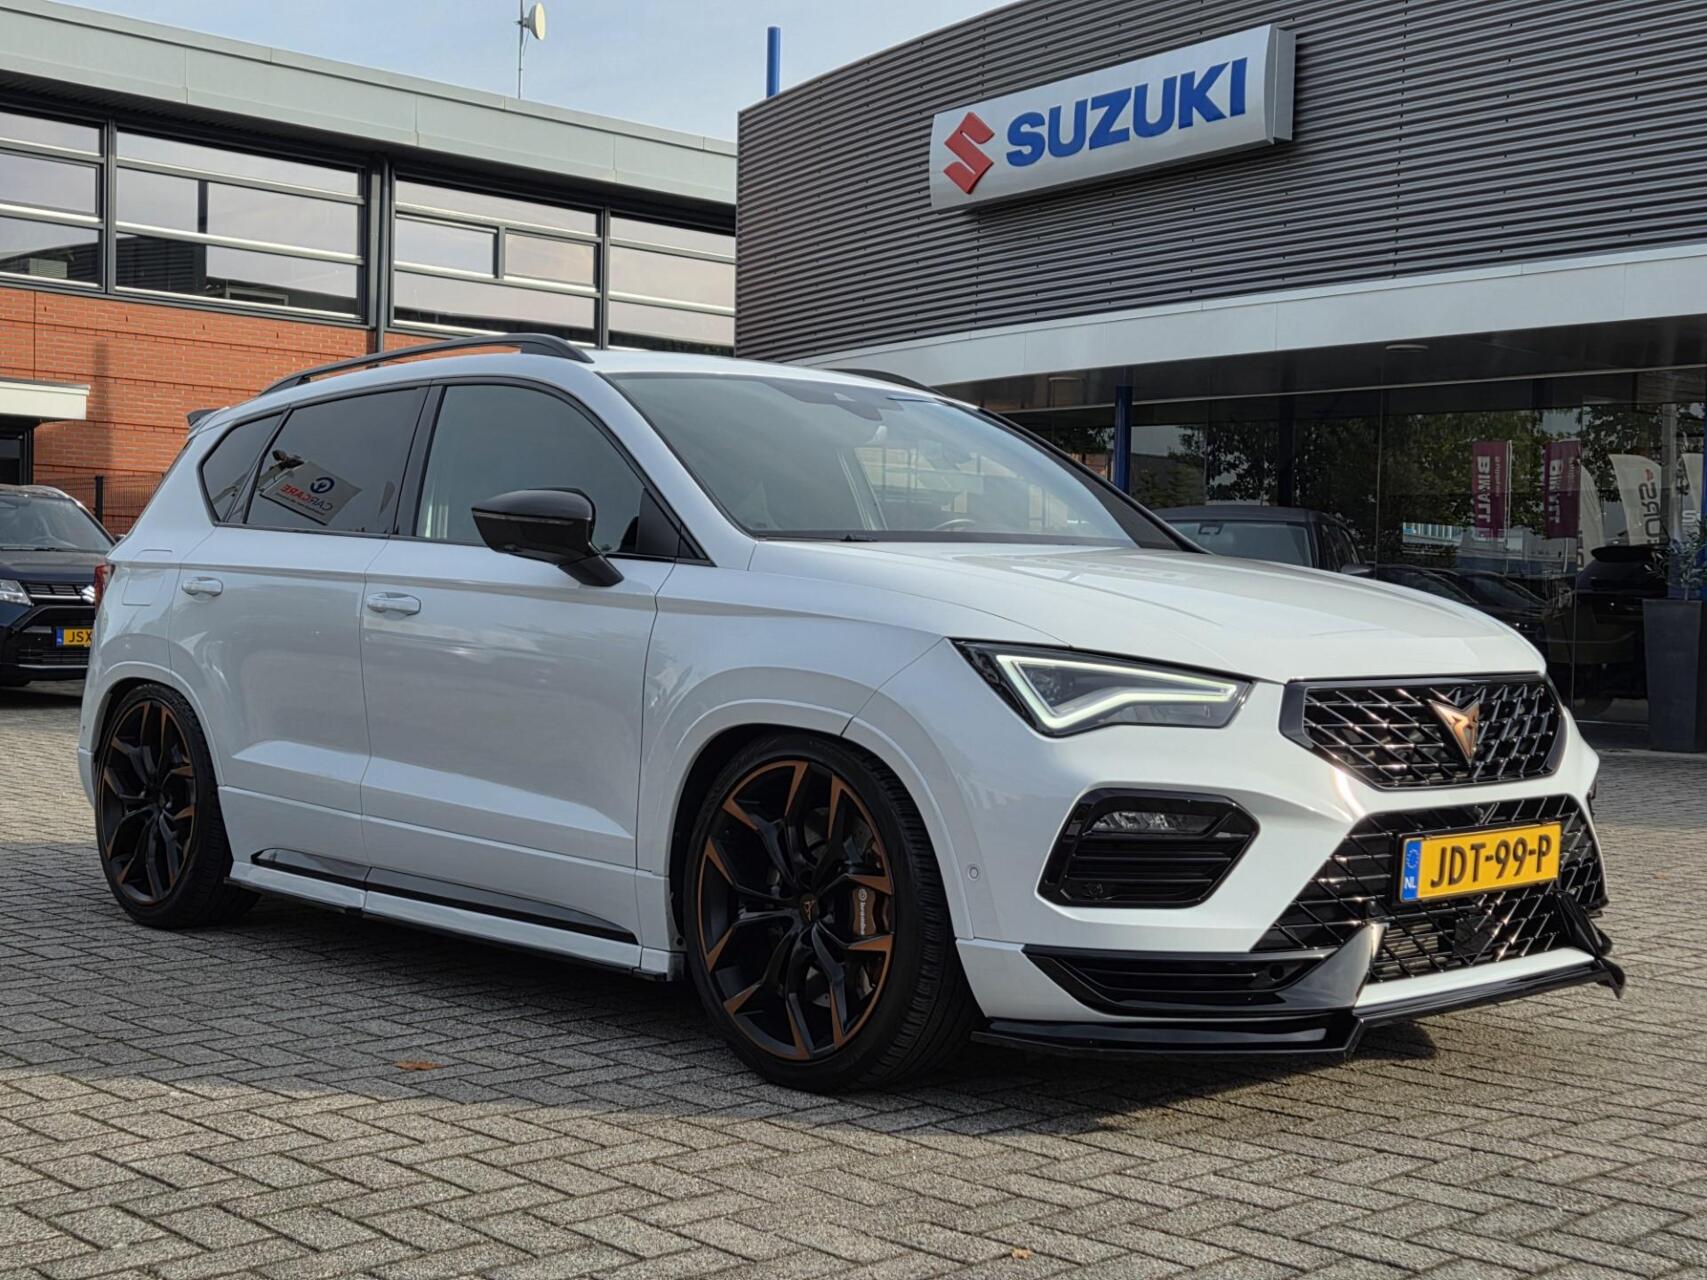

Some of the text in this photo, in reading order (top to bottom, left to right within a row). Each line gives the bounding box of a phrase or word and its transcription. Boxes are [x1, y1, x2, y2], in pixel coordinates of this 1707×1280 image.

[1006, 57, 1248, 167] SUZUKI
[1404, 876, 1417, 890] NL
[1430, 834, 1552, 888] JDT-99-P
